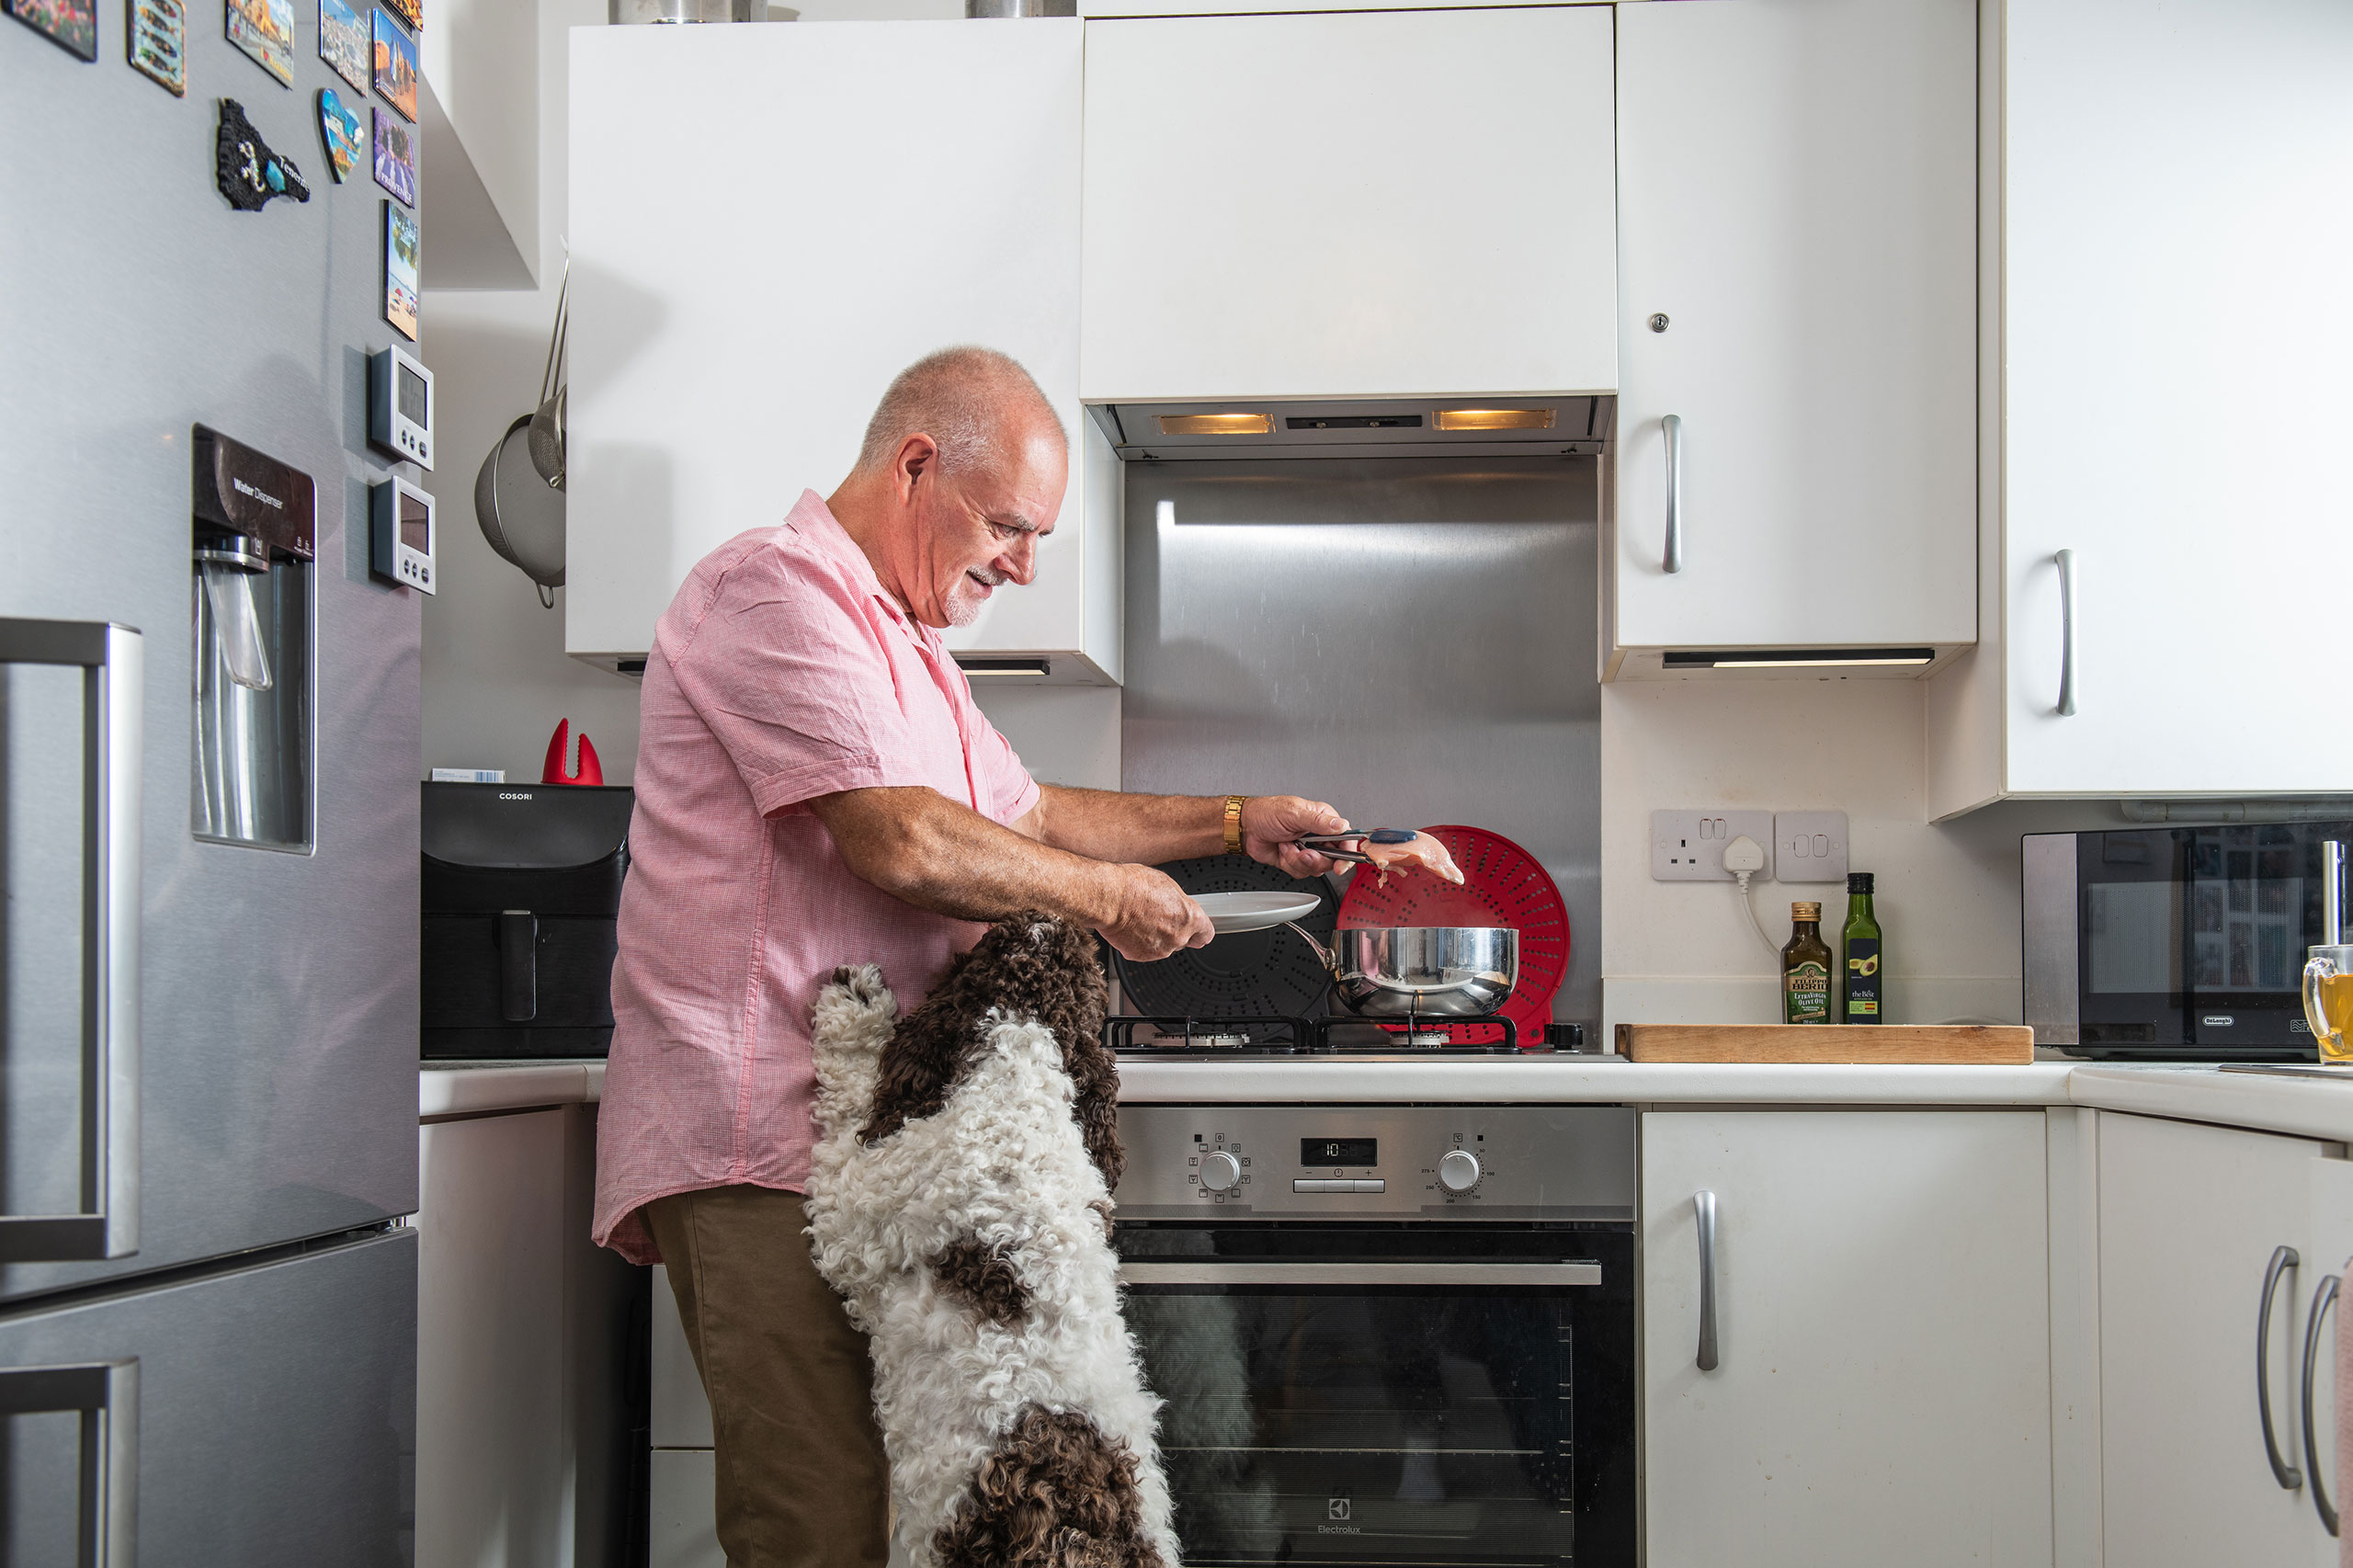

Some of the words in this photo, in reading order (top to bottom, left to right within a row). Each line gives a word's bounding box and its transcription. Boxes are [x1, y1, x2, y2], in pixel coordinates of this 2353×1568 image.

[381, 172, 413, 203] PROVENCE
[233, 477, 255, 496] Water
[255, 486, 283, 509] Dispenser
[1317, 1525, 1360, 1534] Electrolux
